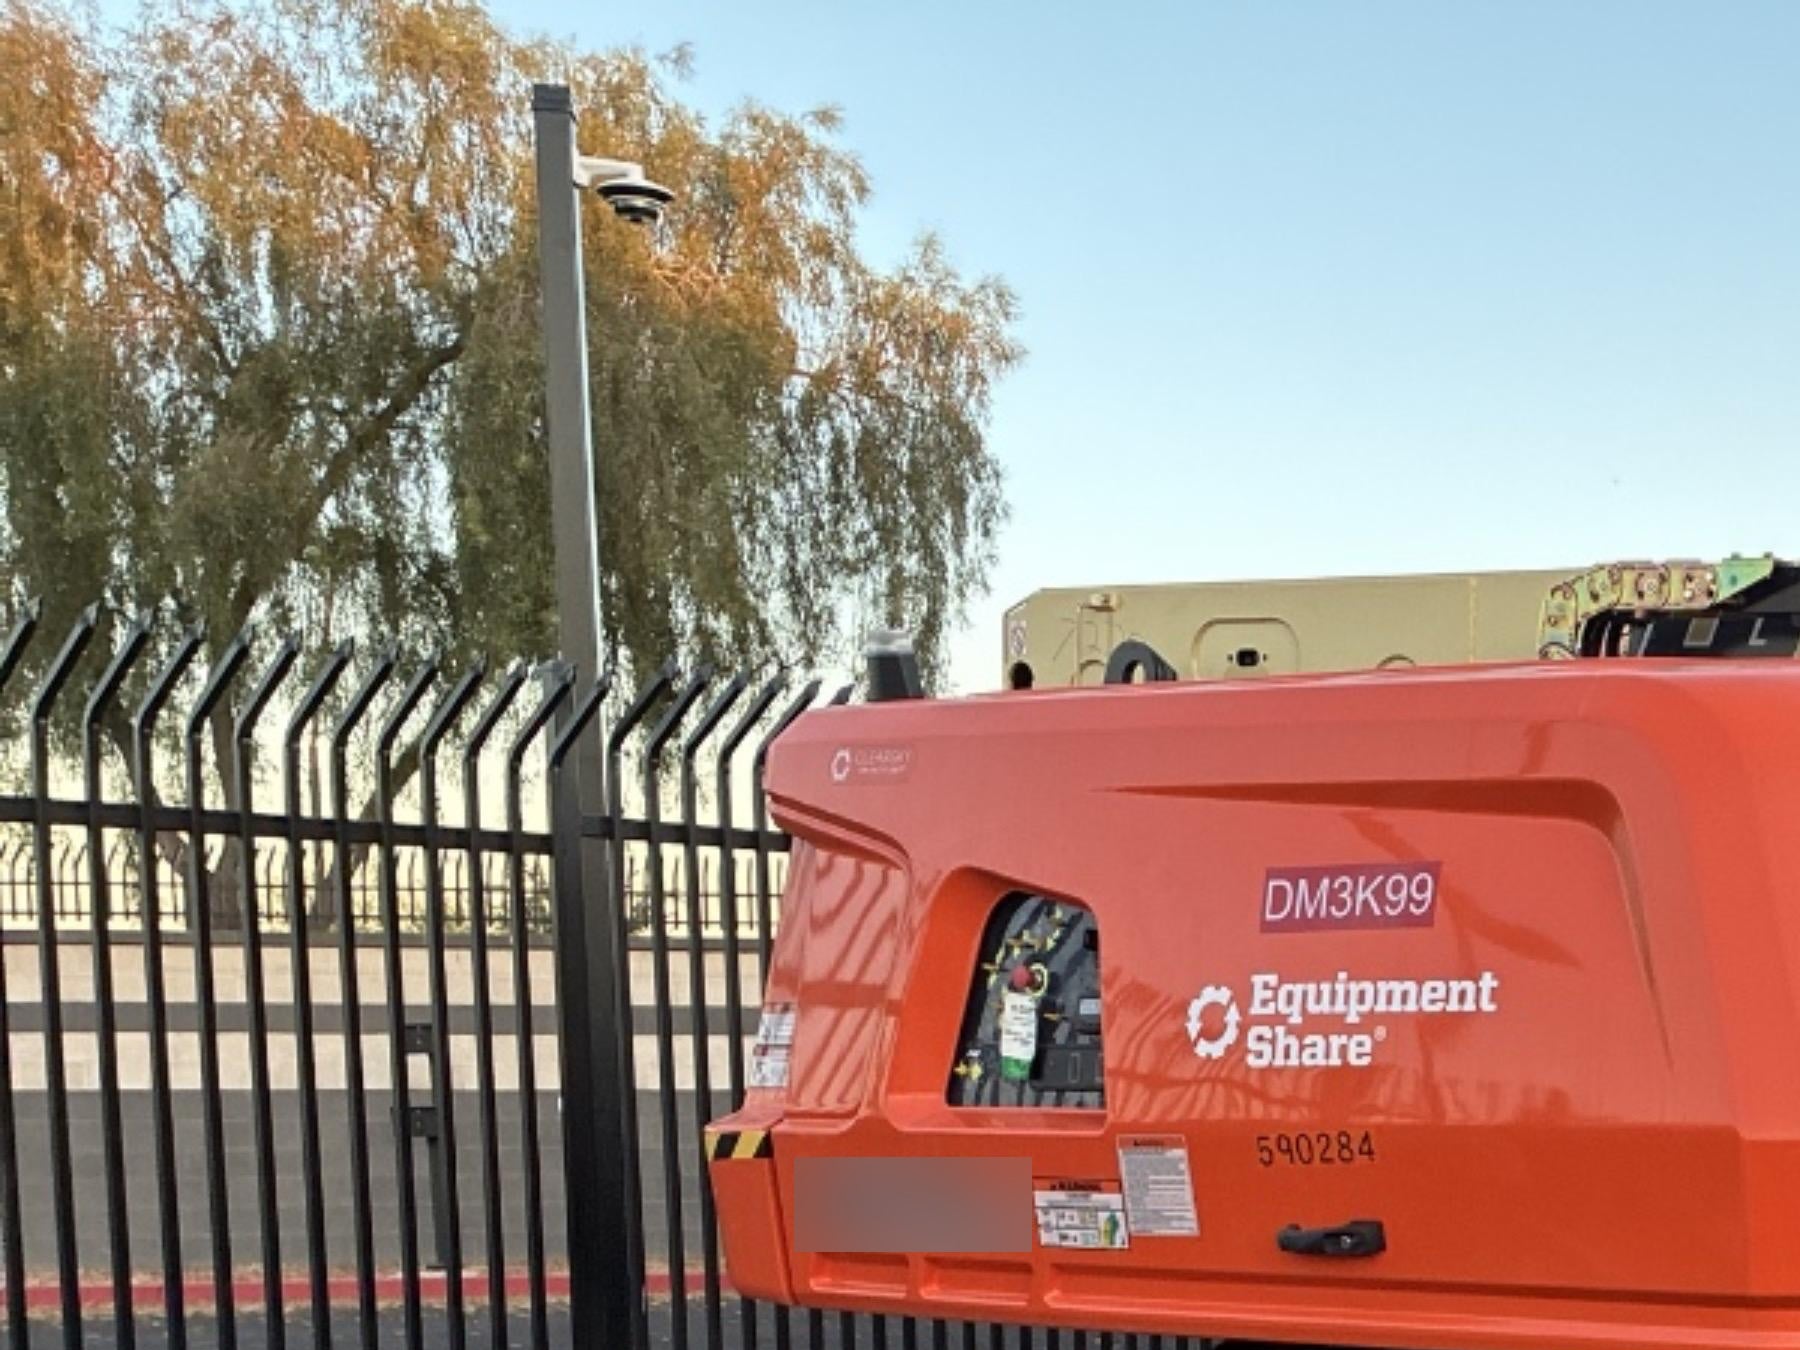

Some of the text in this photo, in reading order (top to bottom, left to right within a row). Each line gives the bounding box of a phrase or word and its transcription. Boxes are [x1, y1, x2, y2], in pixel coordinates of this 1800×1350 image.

[1264, 872, 1435, 922] DM3K99
[1249, 971, 1499, 1024] Equipment
[1256, 1131, 1376, 1168] 590284
